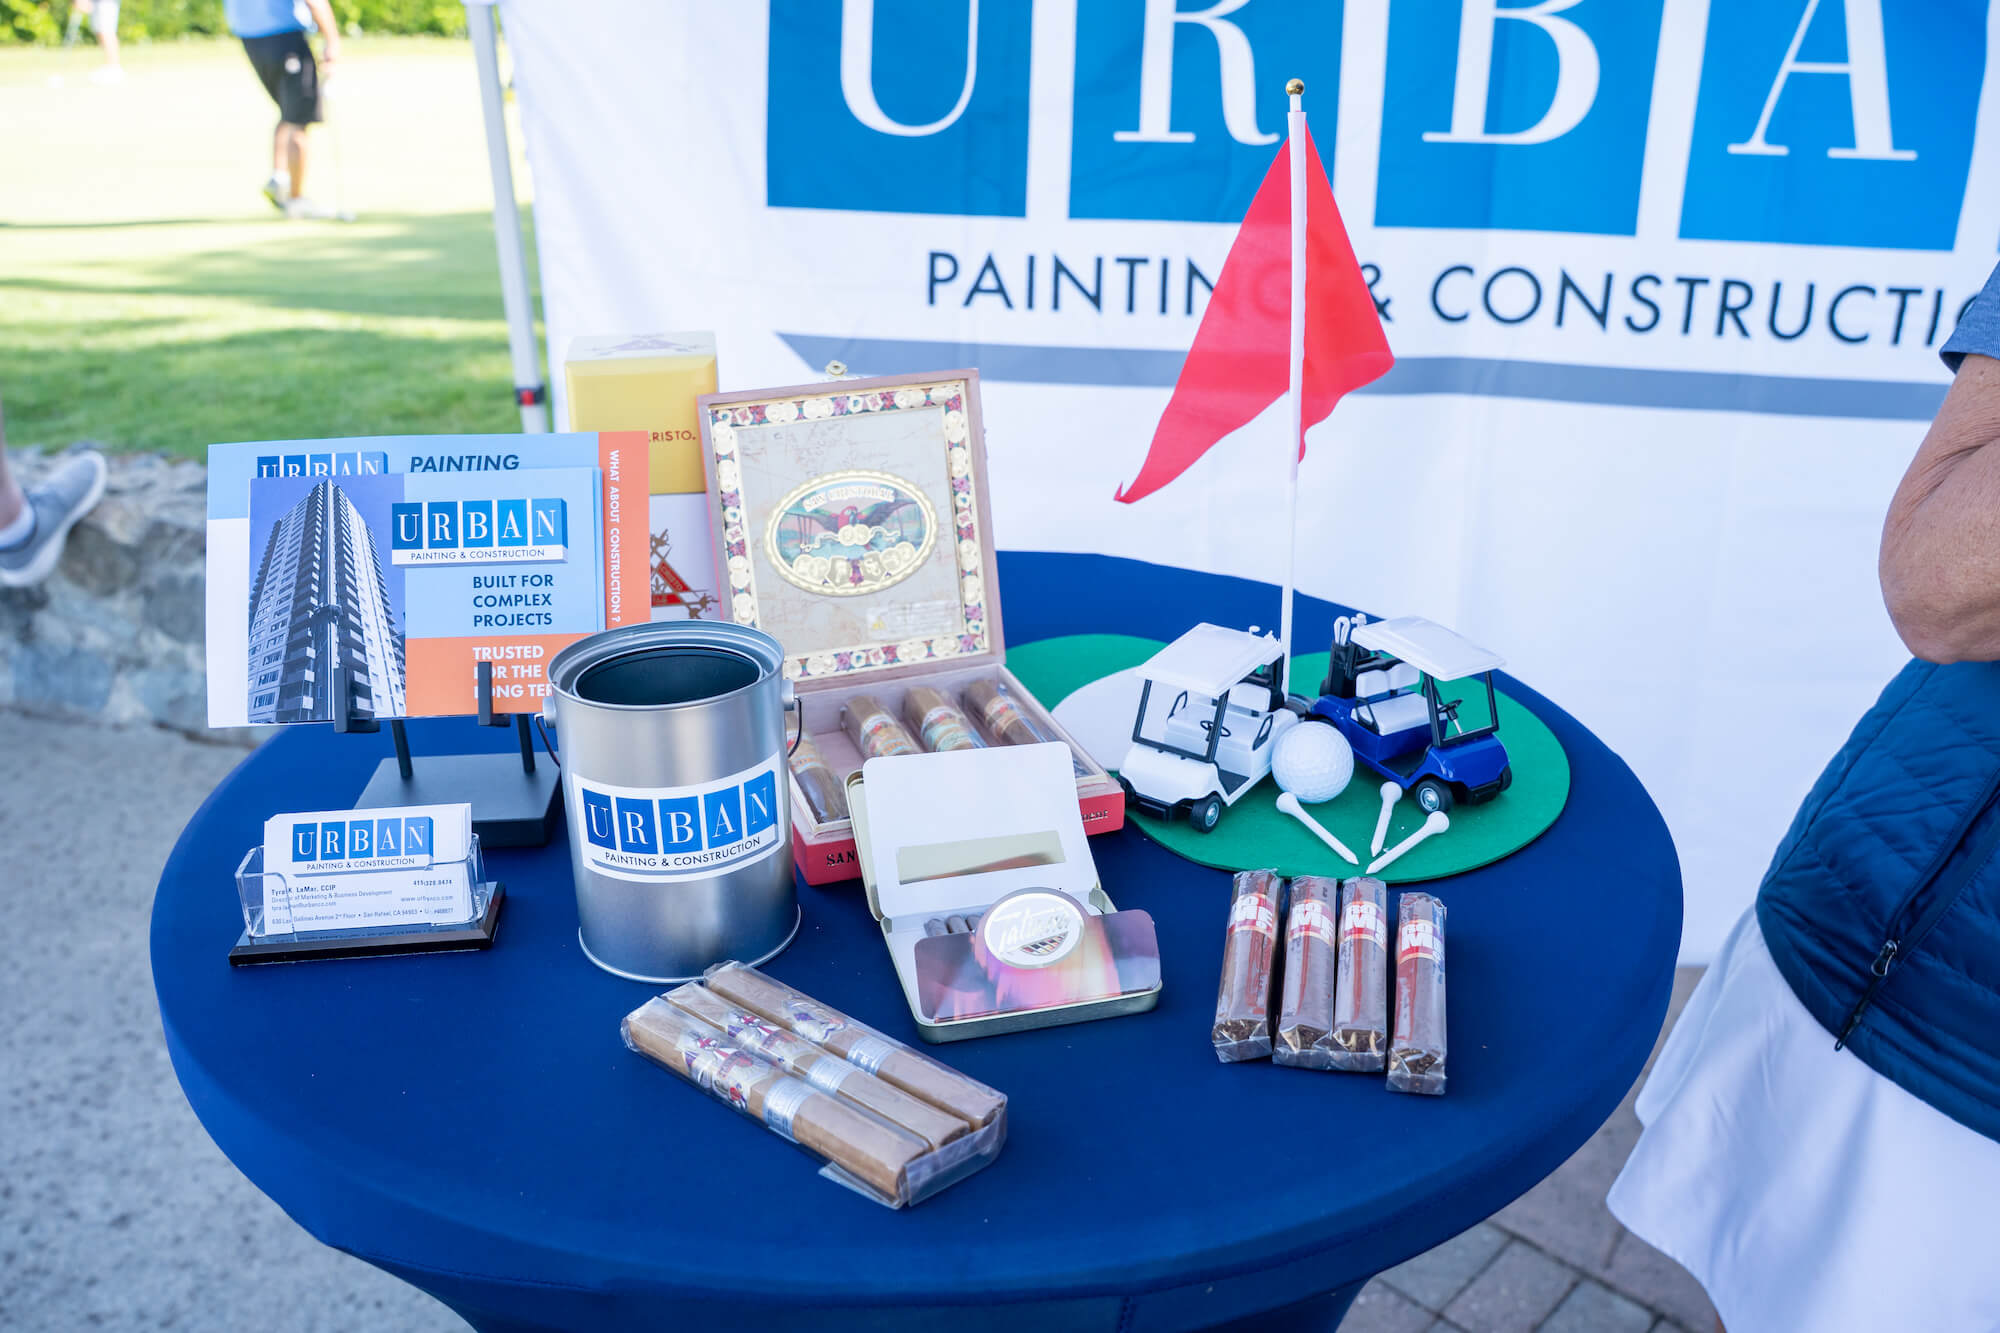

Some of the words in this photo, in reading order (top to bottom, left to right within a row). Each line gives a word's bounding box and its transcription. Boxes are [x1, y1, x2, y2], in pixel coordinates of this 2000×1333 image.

[841, 0, 1919, 161] URBA
[1361, 263, 1393, 322] &
[1431, 264, 1976, 348] CONSTRUCTI
[649, 430, 697, 442] RISTO.
[409, 454, 520, 472] PAINTING
[609, 450, 619, 482] WHAT
[609, 486, 619, 523] ABOUT
[397, 509, 556, 542] URBAN
[411, 550, 456, 561] PAINTING
[459, 551, 467, 559] &
[469, 548, 545, 559] CONSTRUCTION
[609, 528, 621, 614] CONSTRUCTION
[473, 575, 517, 588] BUILT
[521, 574, 554, 587] FOR
[473, 593, 552, 608] COMPLEX
[473, 612, 553, 627] PROJECTS
[472, 645, 544, 661] TRUSTED
[511, 664, 542, 679] THE
[527, 683, 553, 698] TER
[588, 787, 769, 845] URBAN
[296, 825, 425, 855] URBAN
[605, 851, 657, 867] PAINTING
[661, 857, 671, 866] &
[674, 836, 761, 867] CONSTRUCTION
[306, 863, 344, 871] PAINTING
[354, 858, 415, 868] CONSTRUCTION
